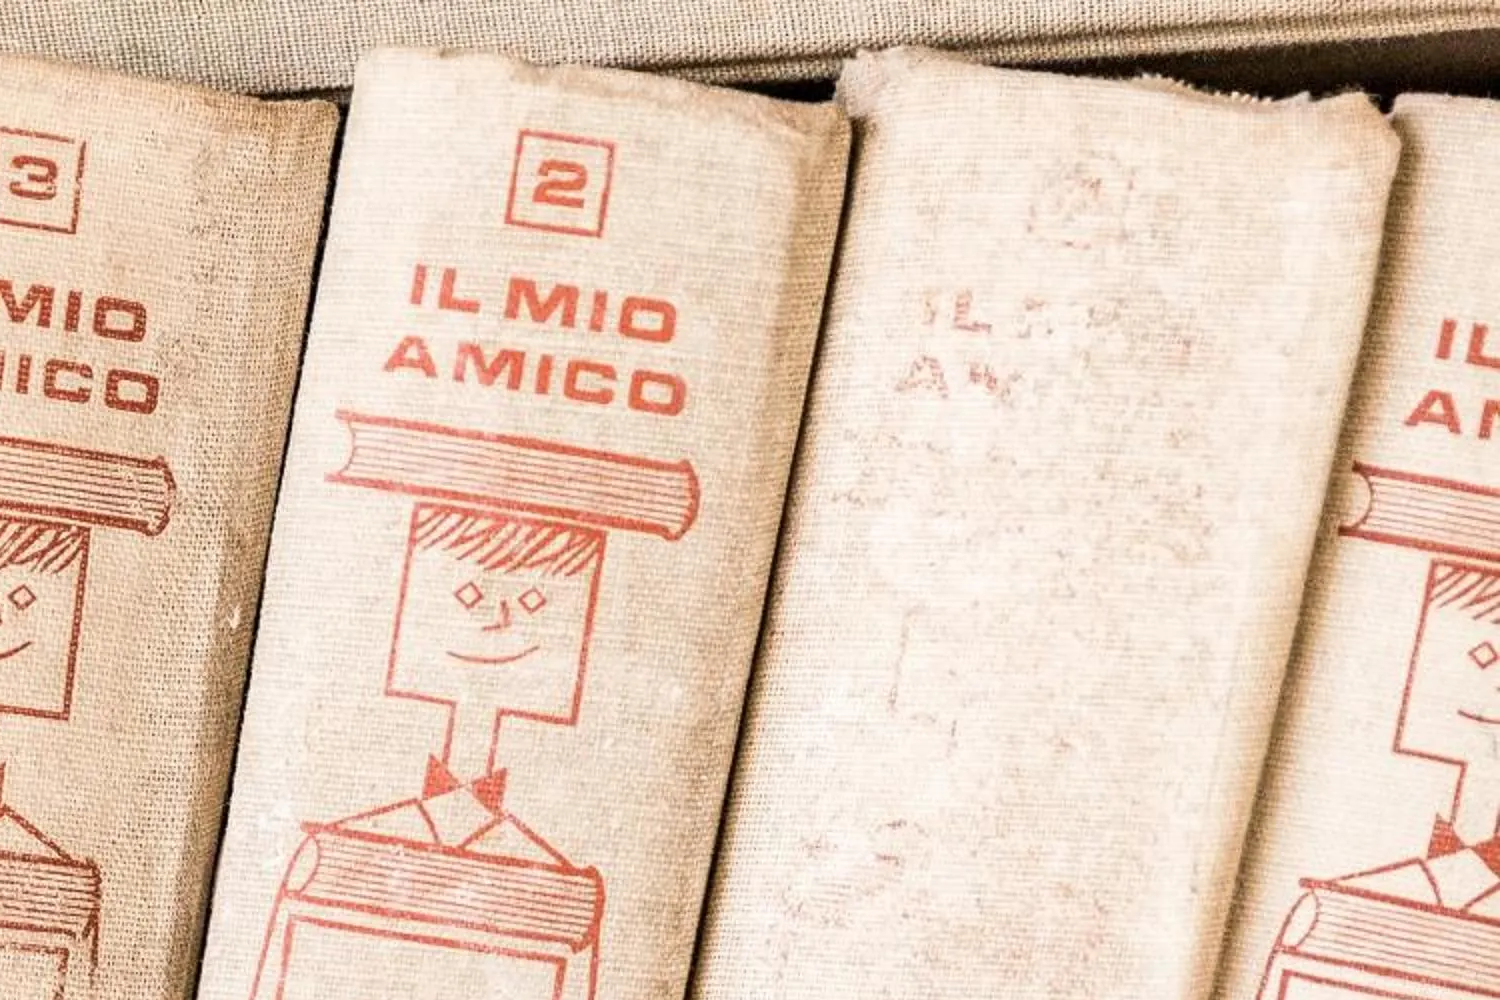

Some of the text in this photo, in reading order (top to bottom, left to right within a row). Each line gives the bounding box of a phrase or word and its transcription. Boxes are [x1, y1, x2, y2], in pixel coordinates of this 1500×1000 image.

[9, 154, 59, 201] 3
[533, 159, 588, 208] 2
[411, 263, 679, 344] IL MIO
[1435, 319, 1500, 370] IL
[383, 335, 687, 417] AMICO
